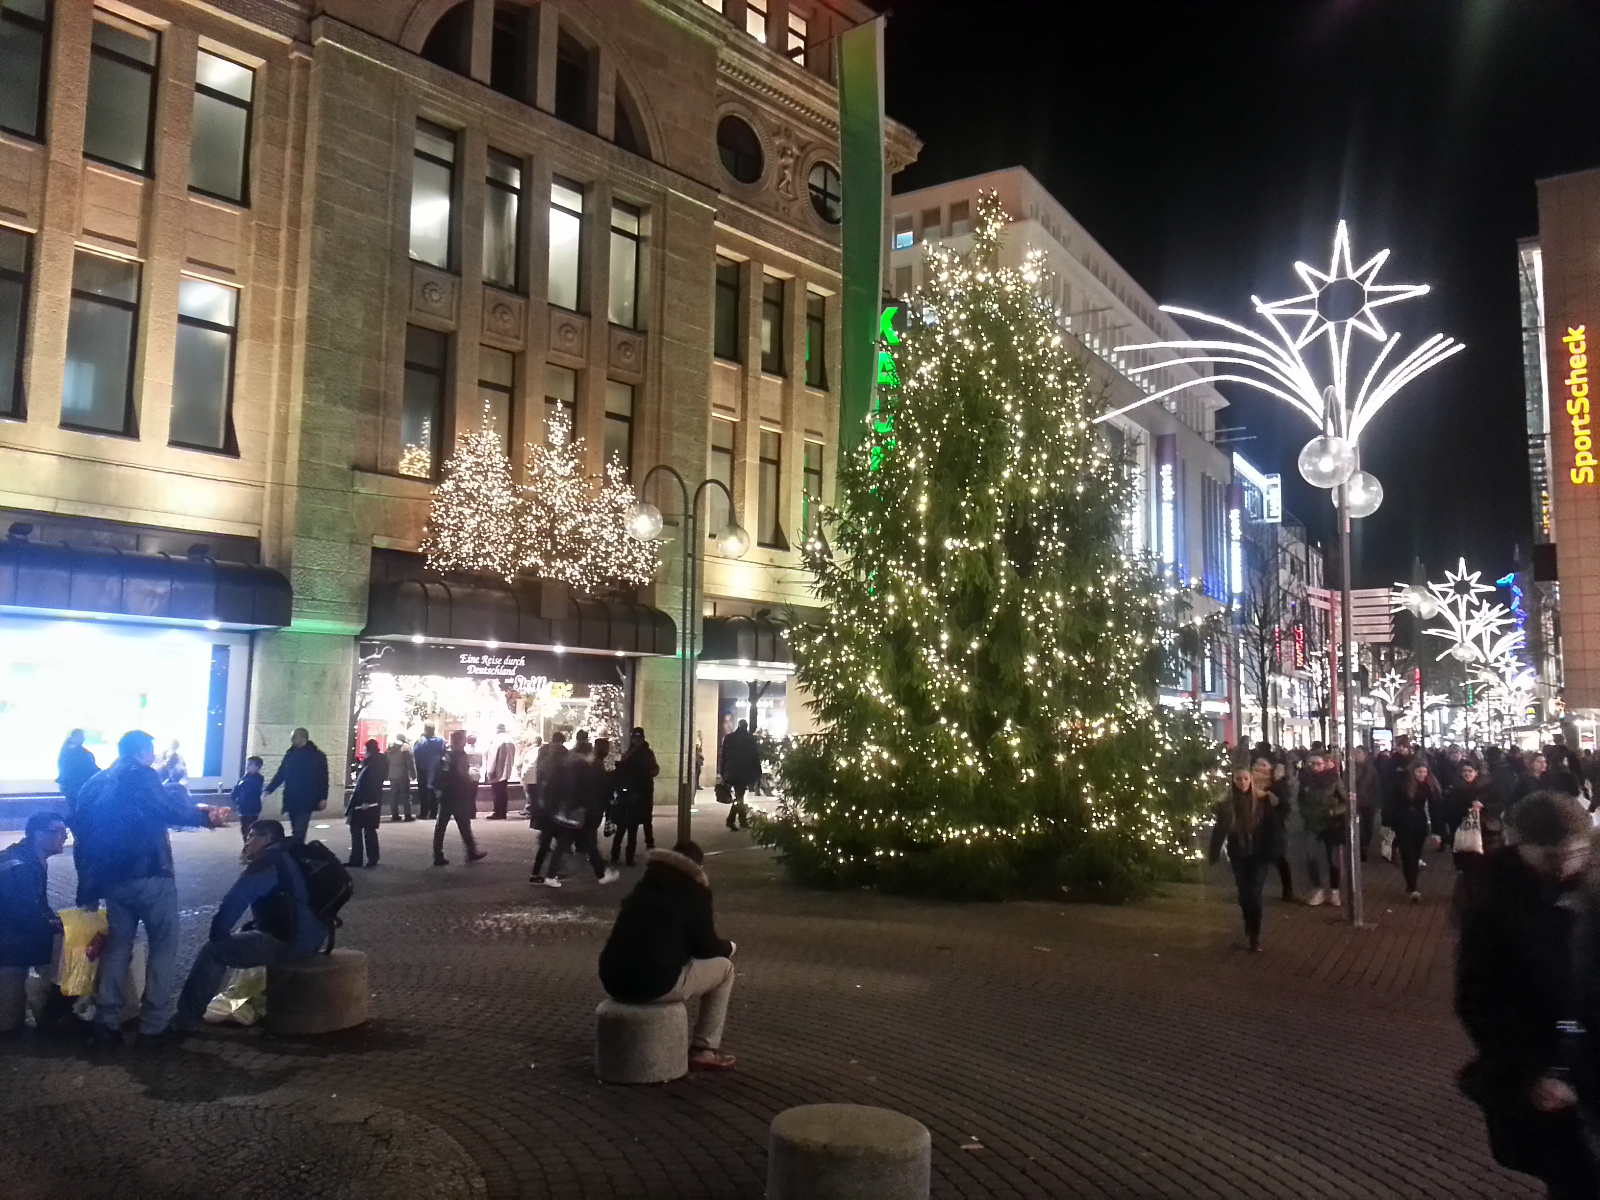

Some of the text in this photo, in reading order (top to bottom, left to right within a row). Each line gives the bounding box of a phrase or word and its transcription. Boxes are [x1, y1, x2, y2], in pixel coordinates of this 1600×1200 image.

[1562, 325, 1598, 486] SportScheck
[460, 654, 525, 666] Eine Reise durch
[467, 665, 517, 675] Deutschland
